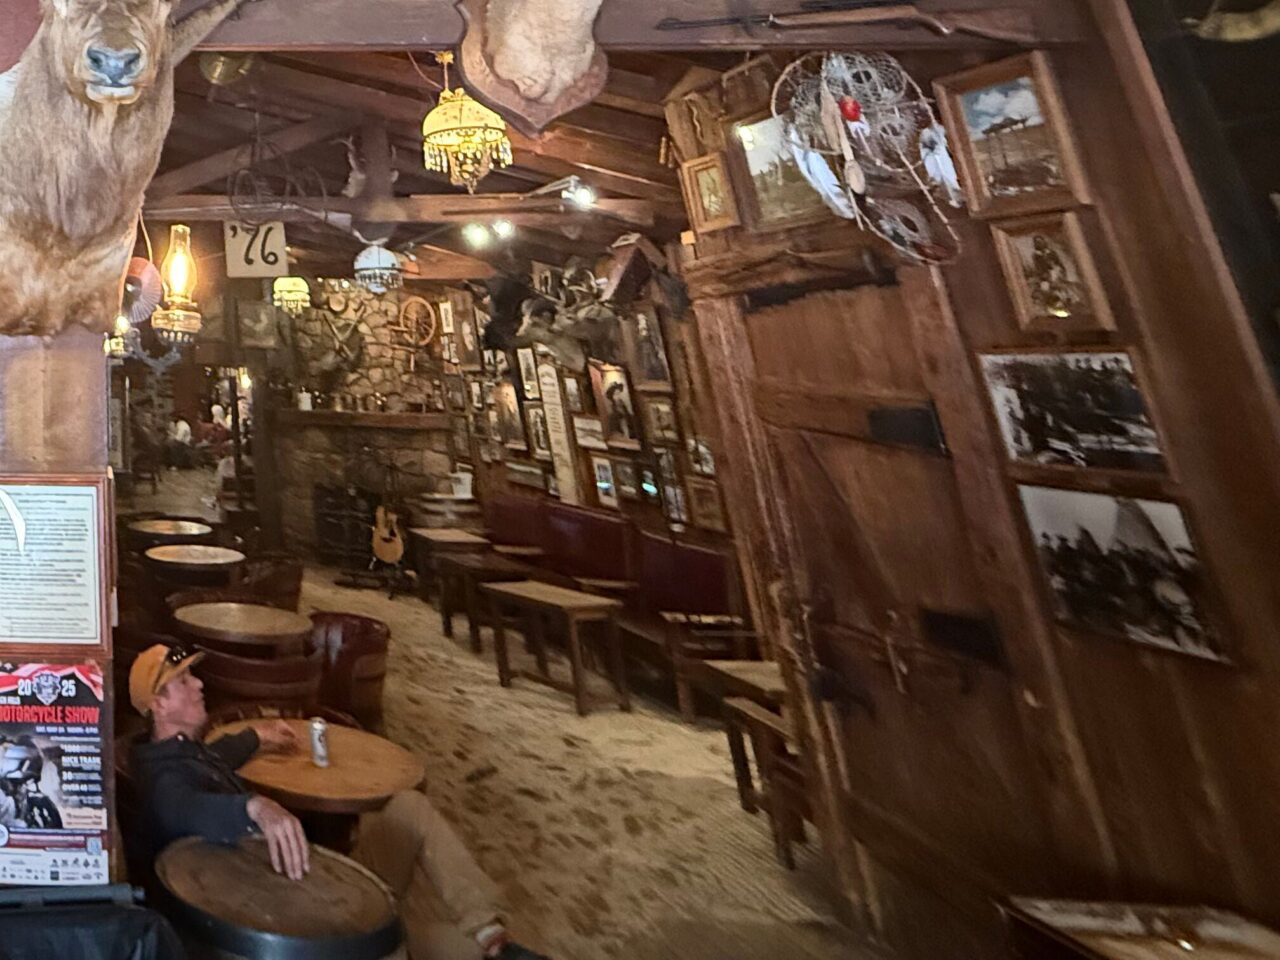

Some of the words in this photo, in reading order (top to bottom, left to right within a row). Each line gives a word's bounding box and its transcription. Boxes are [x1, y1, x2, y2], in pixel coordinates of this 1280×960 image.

[230, 224, 279, 266] '76
[17, 679, 32, 696] 20
[61, 679, 76, 697] 25
[64, 706, 100, 724] SHOW
